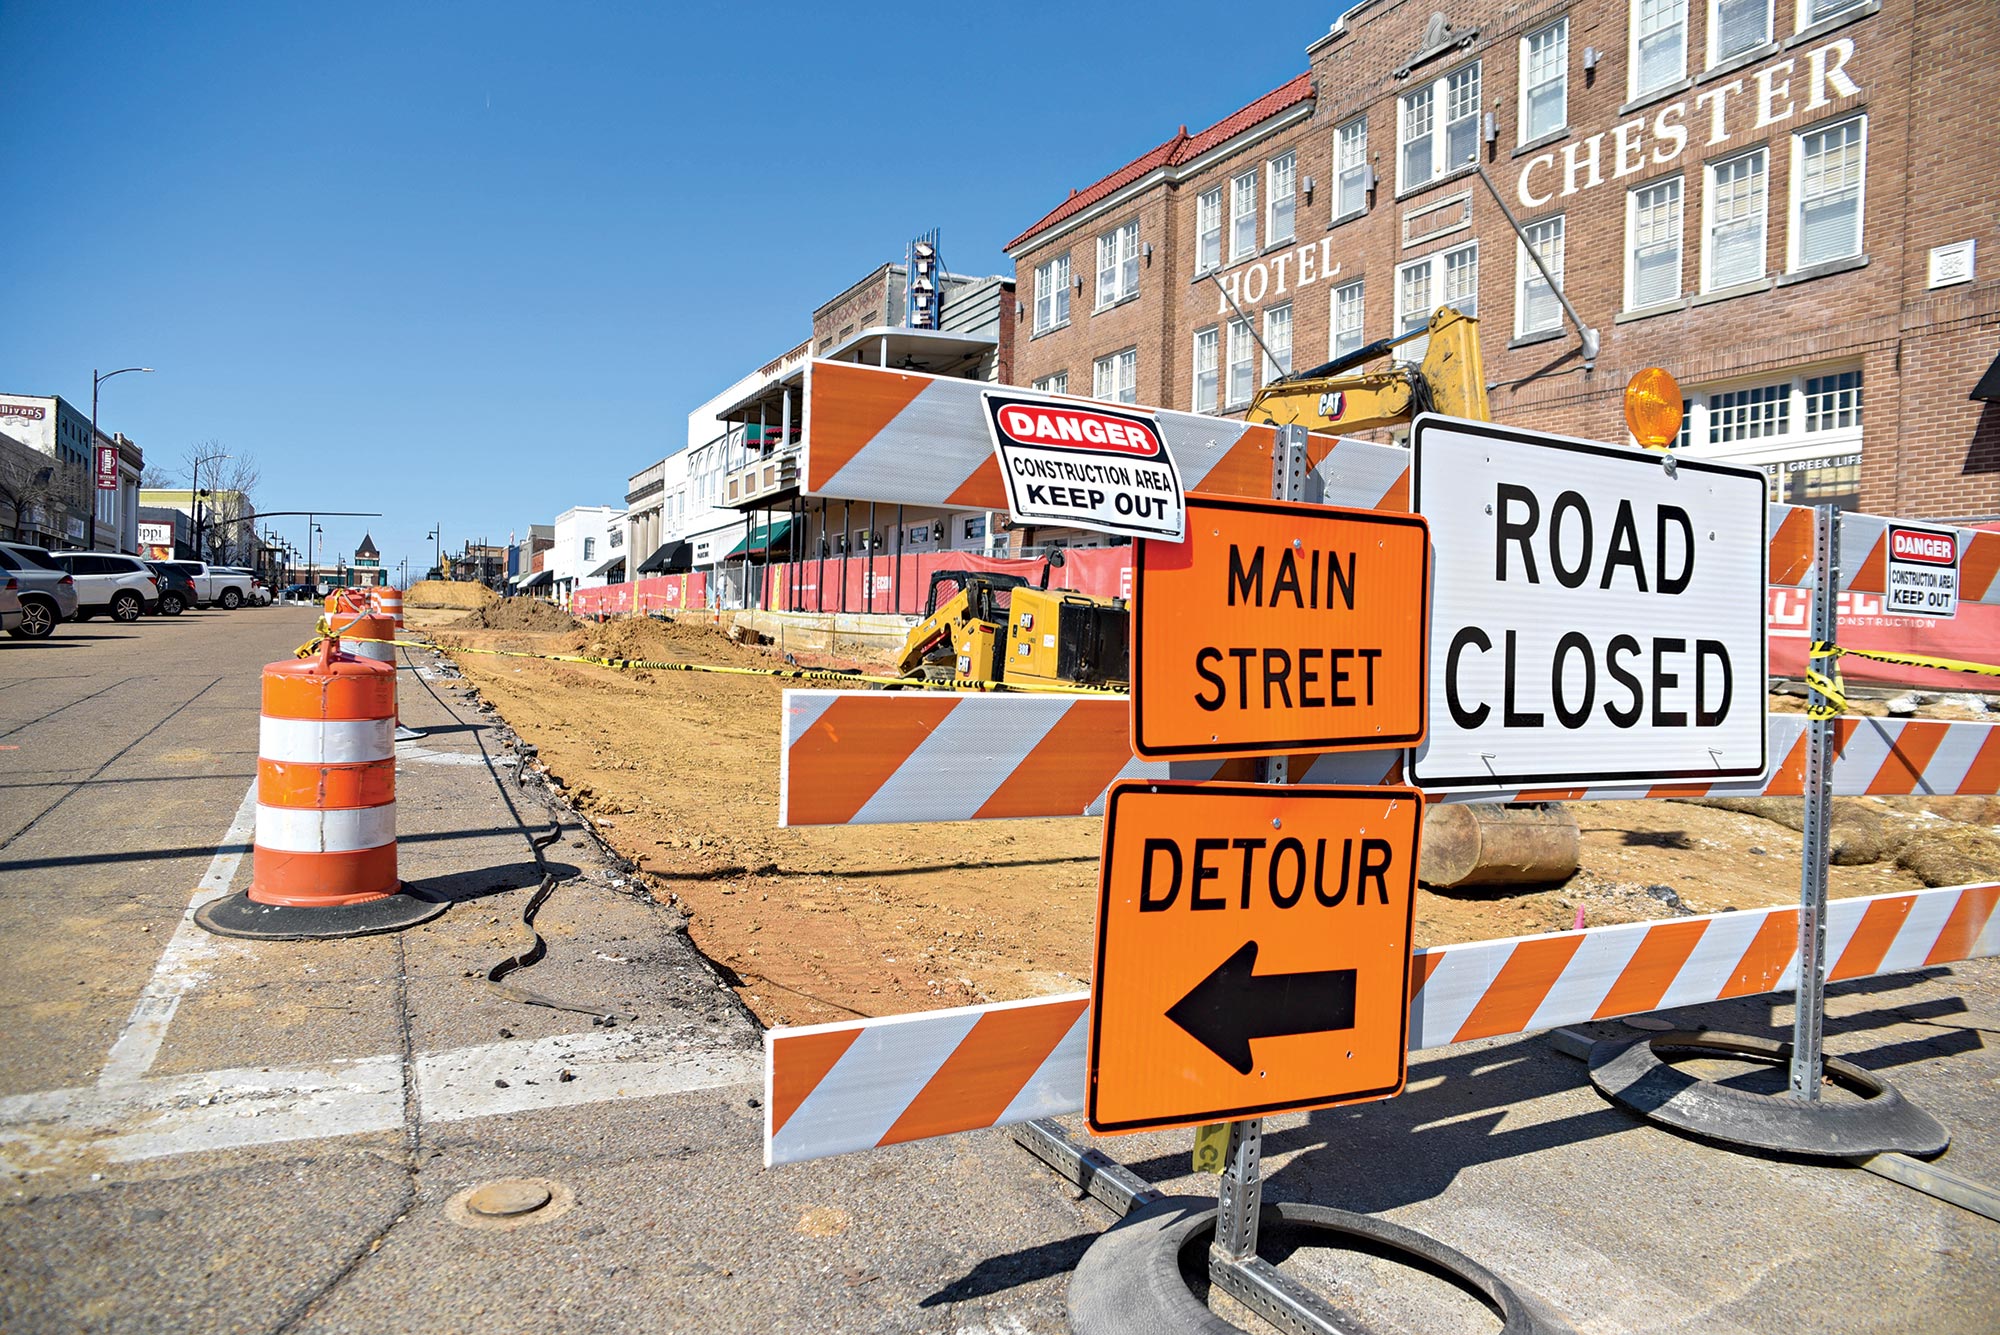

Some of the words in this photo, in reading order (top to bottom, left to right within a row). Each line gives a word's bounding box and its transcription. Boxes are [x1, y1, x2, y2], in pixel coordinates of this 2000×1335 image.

[1517, 37, 1861, 208] CHESTER
[1217, 236, 1341, 315] HOTEL
[1318, 391, 1342, 417] CAT
[1008, 412, 1151, 450] DANGER
[1014, 456, 1131, 486] CONSTRUCTION
[1135, 469, 1172, 492] AREA
[1789, 458, 1831, 472] GREEK
[1026, 484, 1105, 510] KEEP
[1115, 492, 1168, 520] OUT
[1496, 482, 1695, 595] ROAD
[1894, 535, 1951, 559] DANGER
[1227, 544, 1356, 610] MAIN
[1892, 569, 1937, 587] CONSTRUCTION
[1939, 573, 1954, 590] AREA
[1894, 589, 1924, 605] KEEP
[1928, 592, 1951, 608] OUT
[1836, 617, 1937, 628] ONSTRUCTION
[1194, 647, 1382, 711] STREET
[1445, 625, 1733, 730] CLOSED
[1139, 837, 1393, 913] DETOUR
